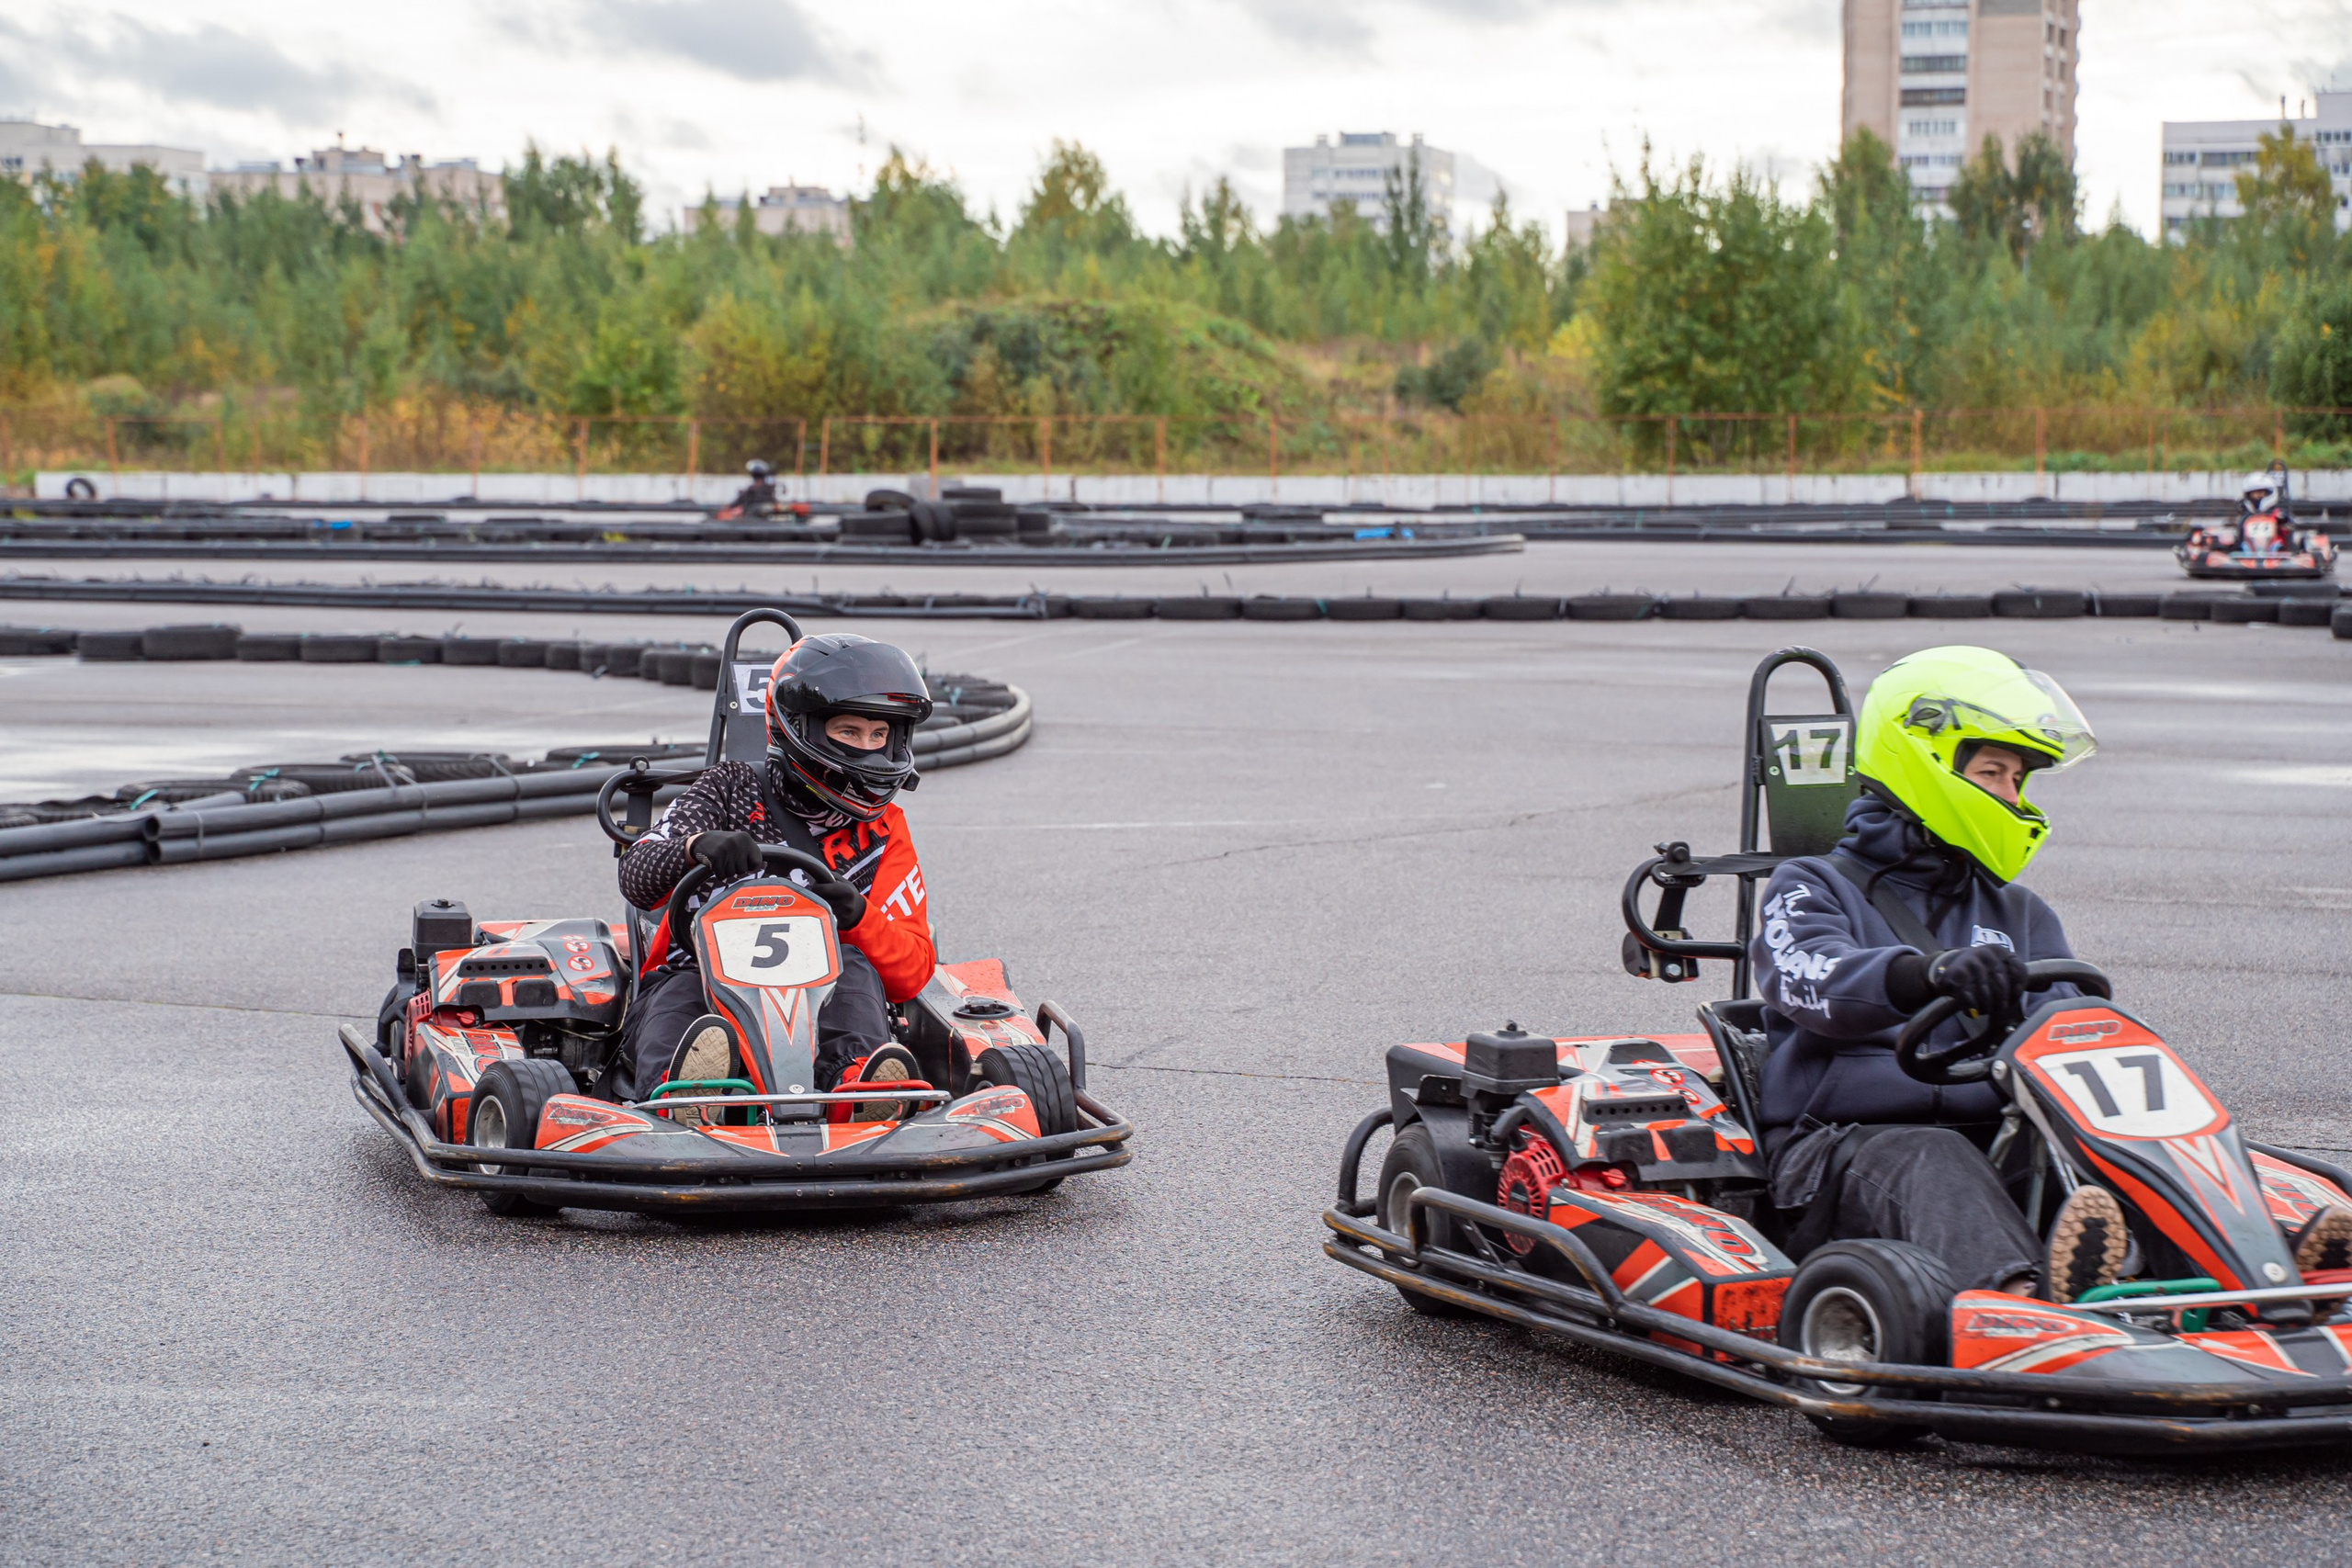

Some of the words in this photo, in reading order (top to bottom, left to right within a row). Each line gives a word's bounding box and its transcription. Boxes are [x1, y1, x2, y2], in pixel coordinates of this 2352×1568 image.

[746, 669, 773, 709] 5
[1772, 728, 1841, 770] 17
[732, 897, 795, 908] DINO
[751, 923, 791, 968] 5
[2050, 1021, 2120, 1039] DINO
[2063, 1054, 2165, 1118] 17
